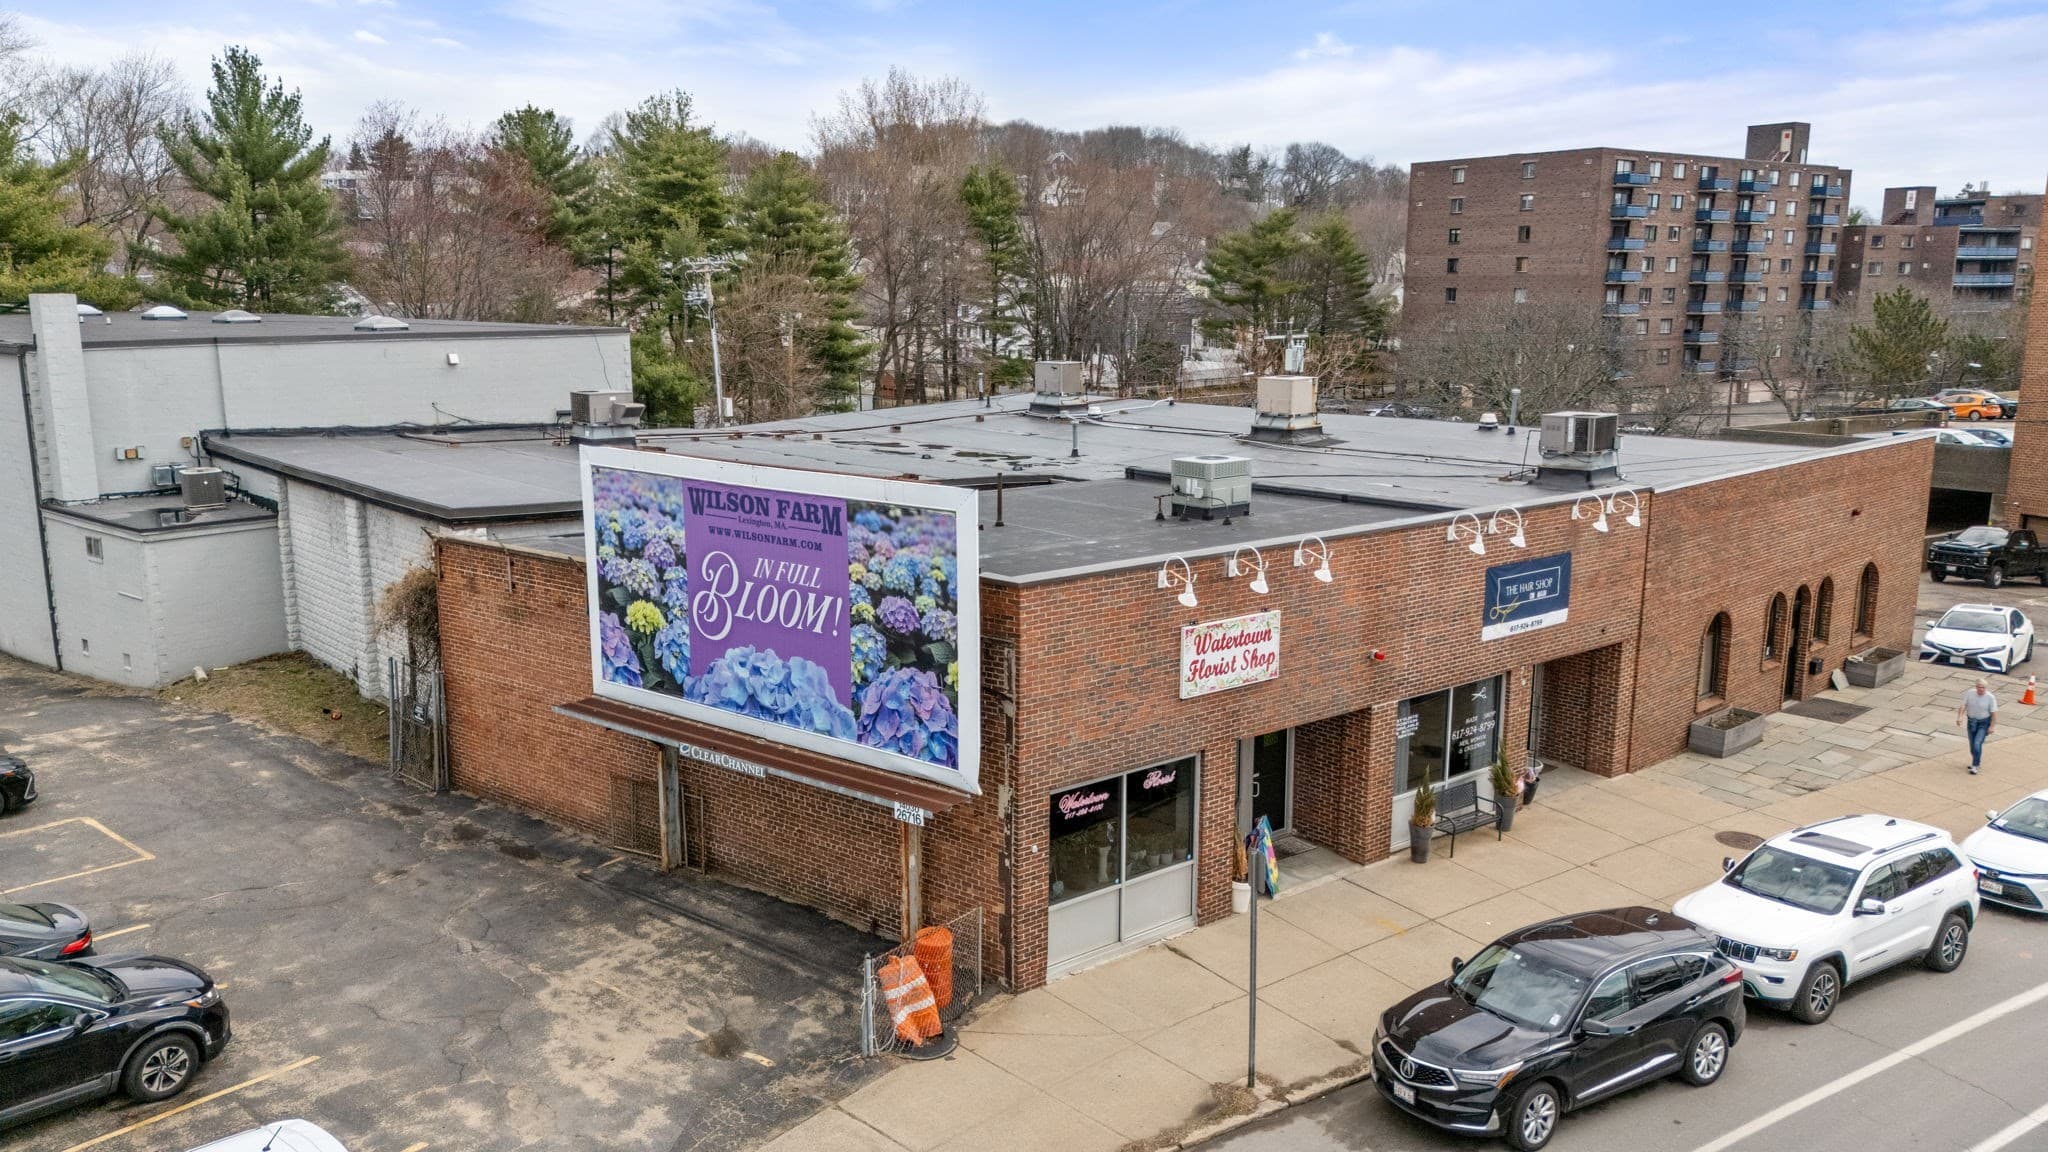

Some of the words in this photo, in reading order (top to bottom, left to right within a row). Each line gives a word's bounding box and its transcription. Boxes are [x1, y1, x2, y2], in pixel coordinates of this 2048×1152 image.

[687, 487, 770, 517] WILSON
[776, 499, 842, 536] FARM
[708, 526, 823, 551] WWW.WILSONFARM.COM
[753, 558, 774, 579] IN
[775, 561, 821, 588] FULL
[1506, 585, 1518, 597] THE
[1520, 581, 1534, 593] HAIR
[1535, 577, 1553, 589] SHOP
[693, 551, 843, 641] BLOOM!
[1194, 628, 1272, 656] Watertown
[1187, 656, 1237, 682] Florist
[1240, 647, 1276, 672] Shop
[1452, 720, 1496, 740] 617-924-8799
[896, 808, 922, 825] 26716
